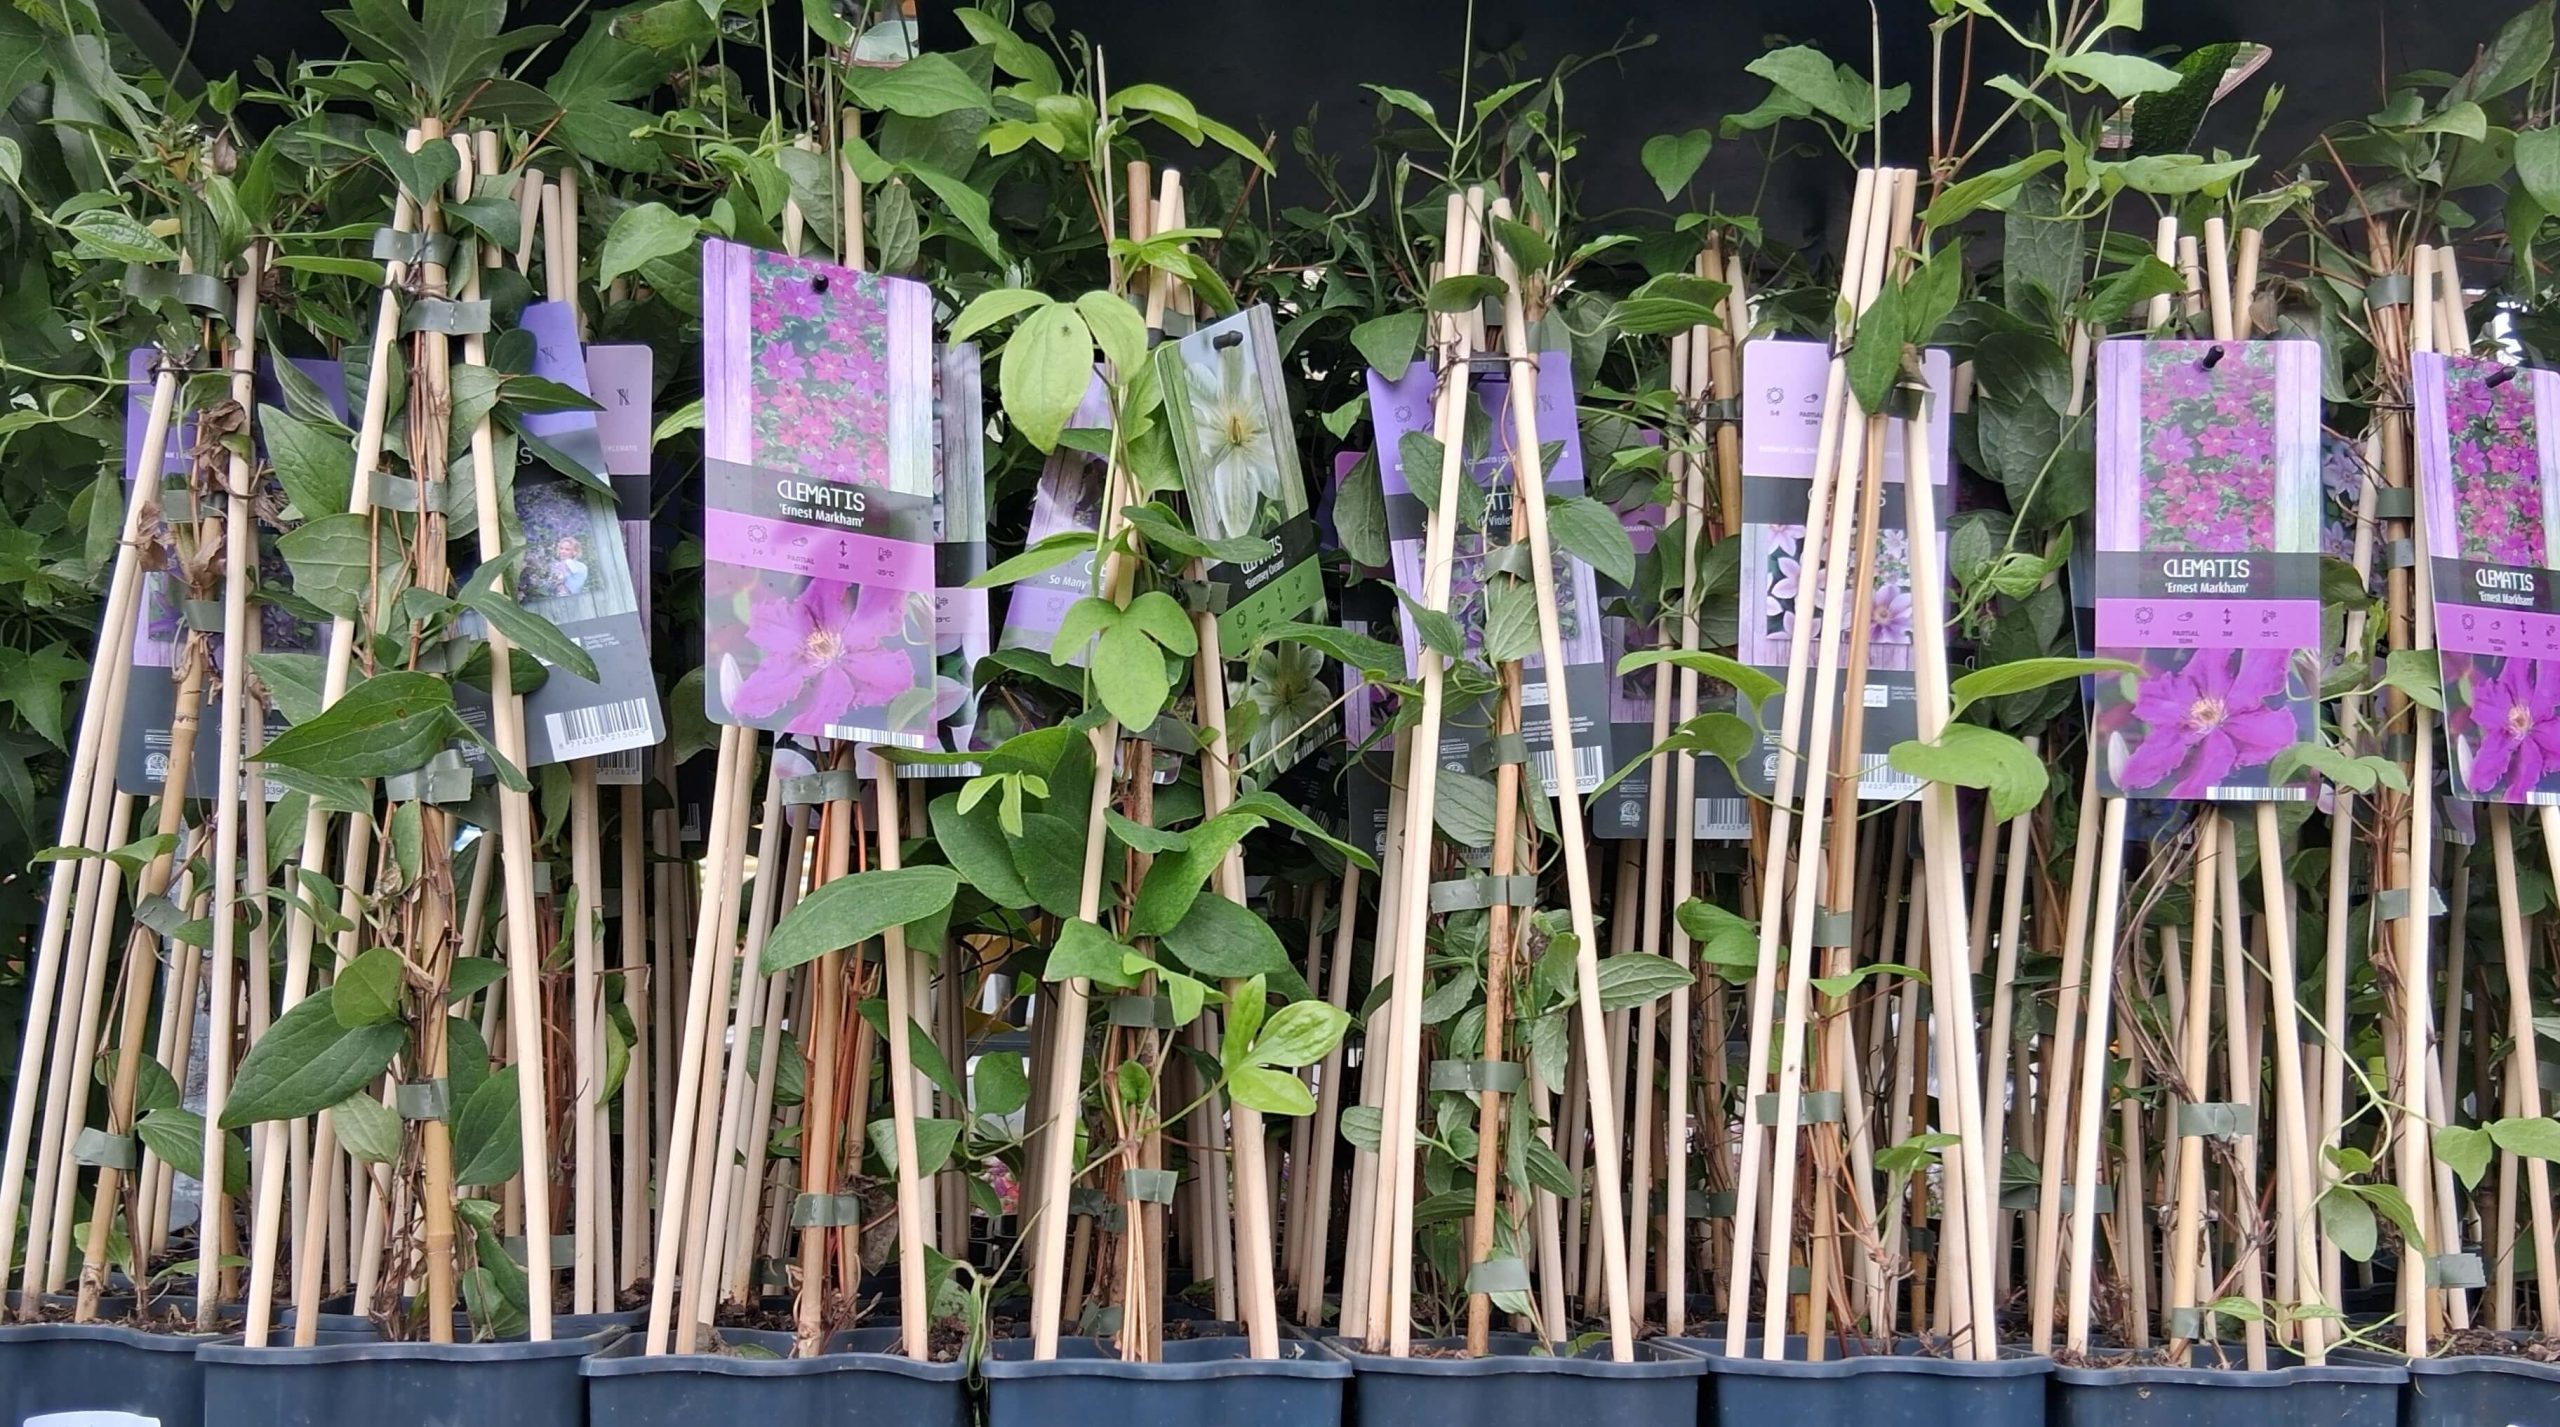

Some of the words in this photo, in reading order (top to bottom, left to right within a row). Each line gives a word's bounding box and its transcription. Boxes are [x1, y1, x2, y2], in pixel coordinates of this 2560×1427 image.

[777, 479, 866, 512] CLEMATIS
[779, 504, 813, 521] 'Ernest
[815, 509, 865, 528] Markham'
[787, 554, 815, 566] PARTIAL
[794, 563, 809, 572] SUN
[2163, 558, 2250, 579] CLEMATIS
[1048, 574, 1061, 585] So
[1062, 576, 1088, 590] Many
[2165, 582, 2198, 594] 'Ernest
[2200, 582, 2249, 594] Markham'
[2475, 568, 2535, 592] CLEMATIS
